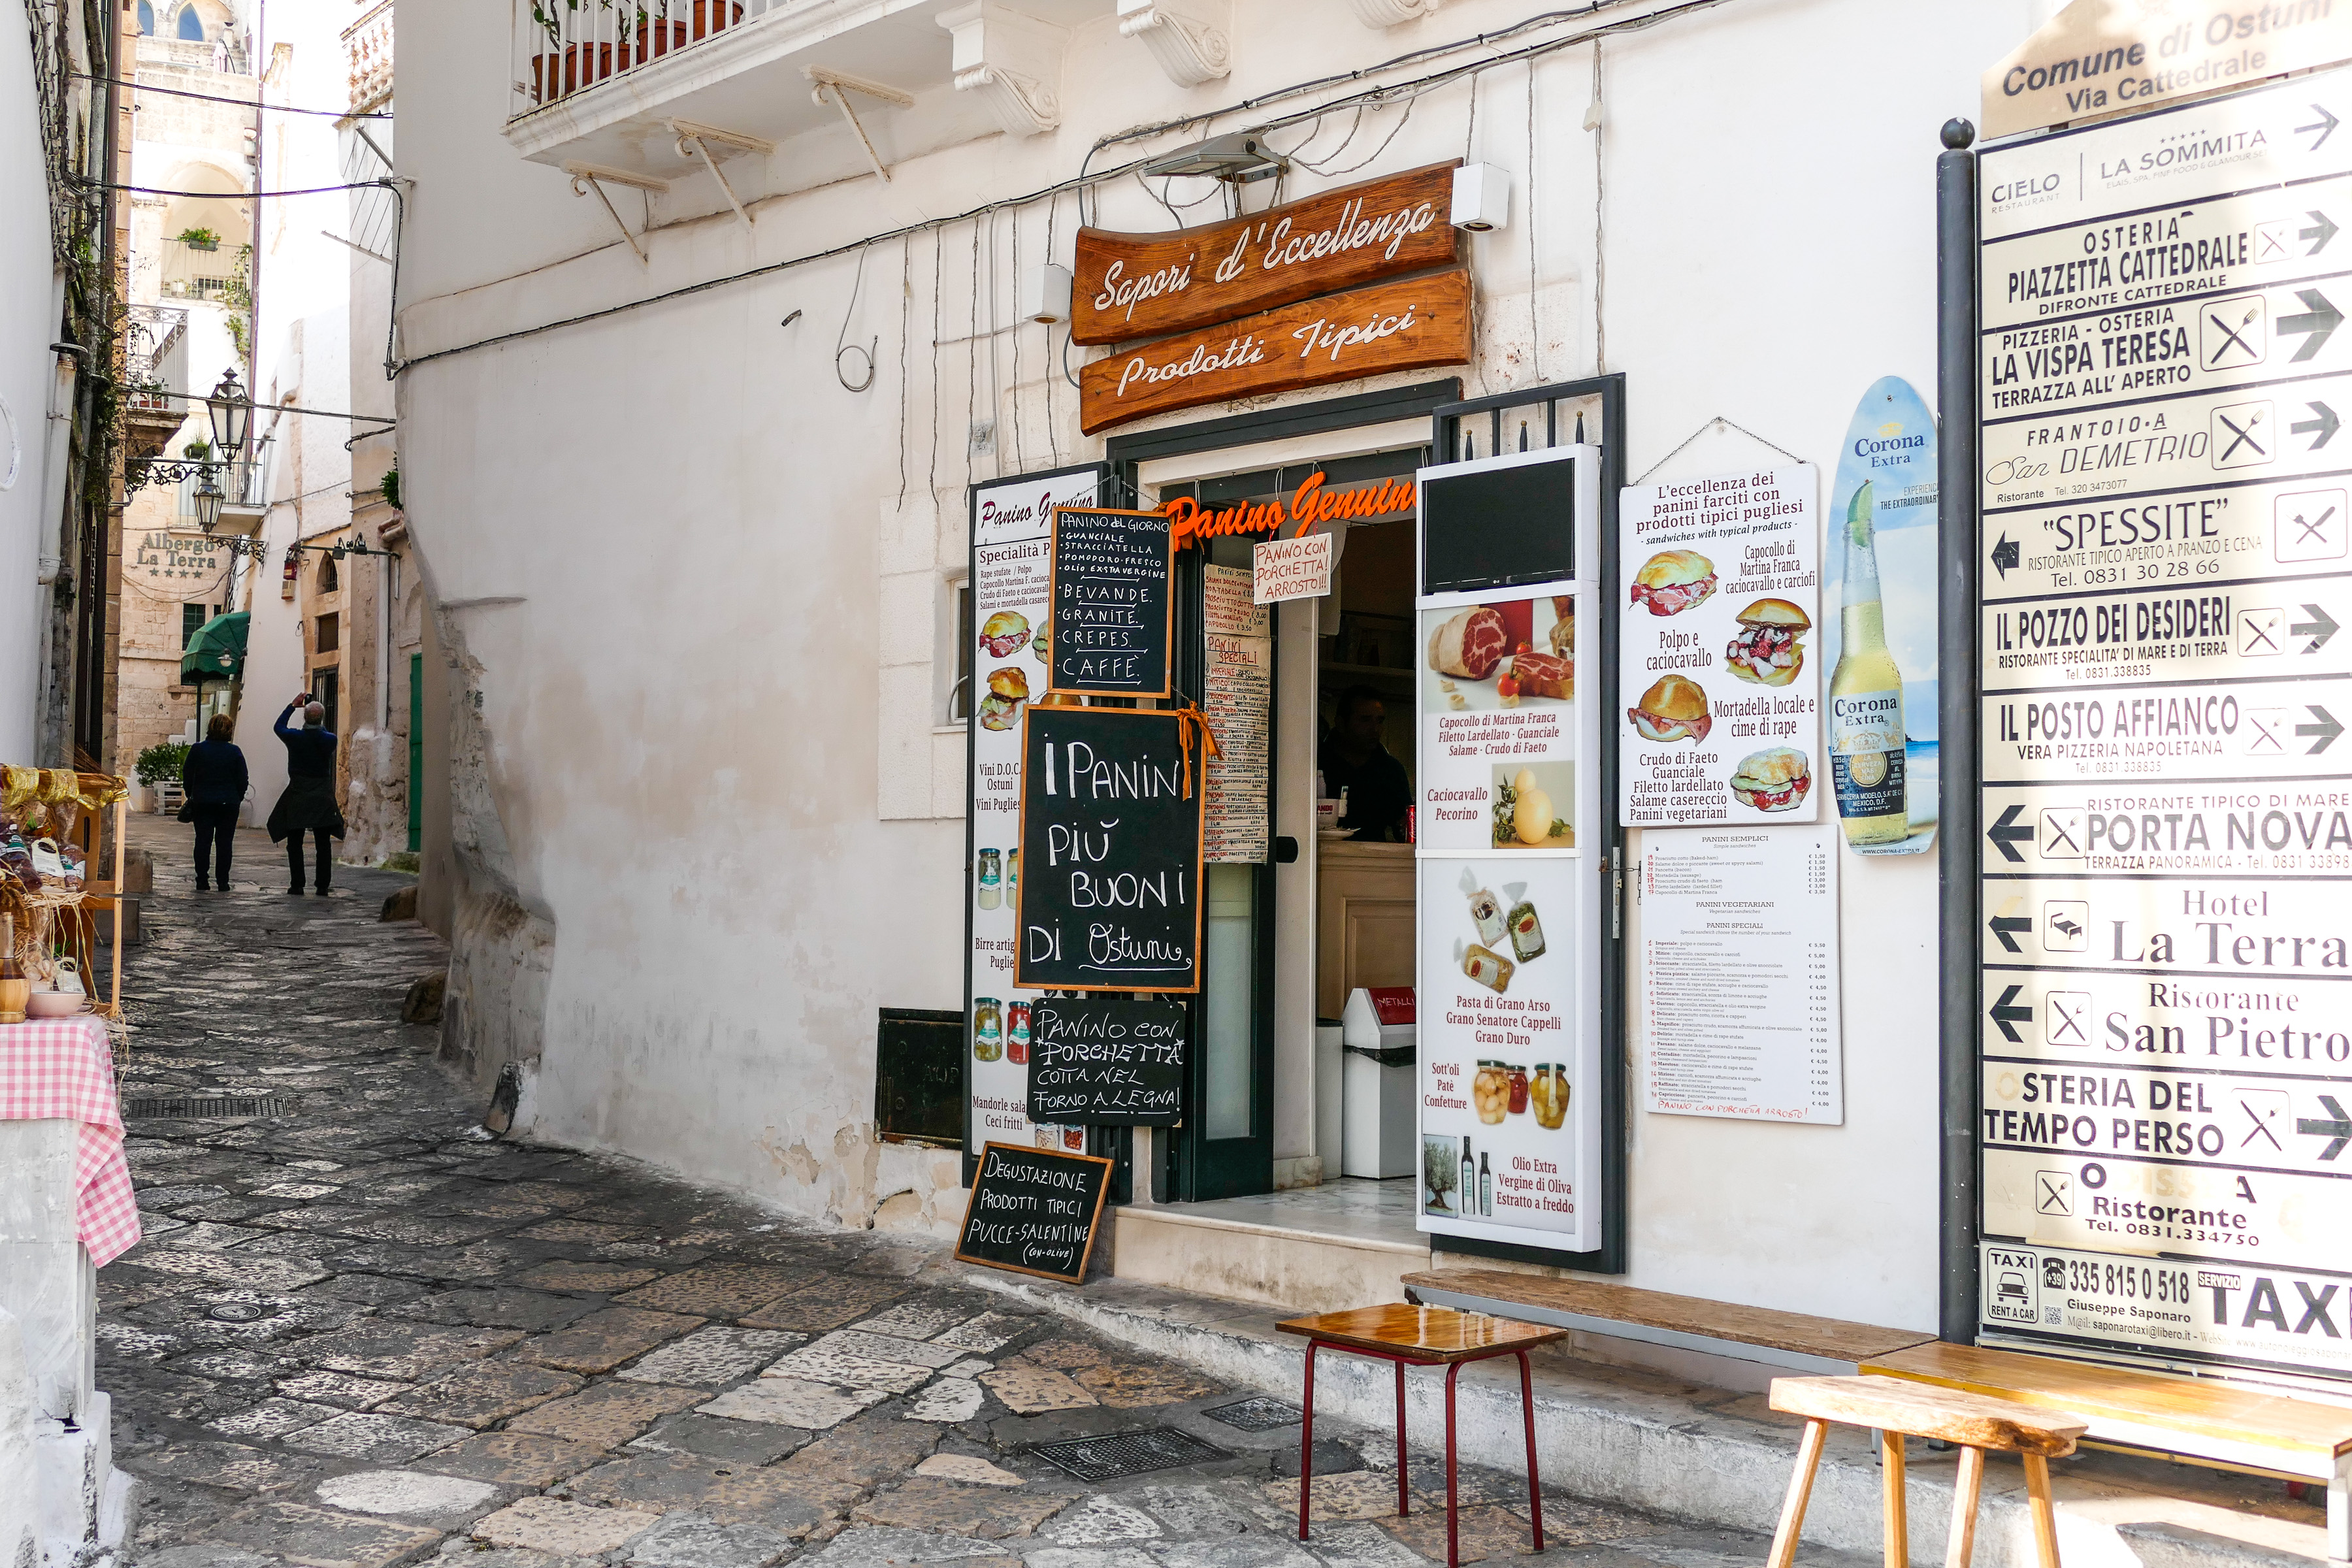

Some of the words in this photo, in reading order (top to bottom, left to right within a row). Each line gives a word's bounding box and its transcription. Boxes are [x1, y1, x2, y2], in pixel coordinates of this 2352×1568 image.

[2003, 41, 2146, 97] Comune
[2159, 20, 2191, 57] di
[2205, 0, 2331, 46] Ostuni
[2066, 88, 2108, 113] Via
[2117, 50, 2267, 101] Cattedrale
[2101, 159, 2131, 179] LA
[1991, 174, 2061, 203] CIELO
[1991, 193, 2061, 214] RESTAURANT
[2083, 218, 2180, 254] OSTERIA
[1094, 253, 1195, 323] Sapori
[1215, 197, 1437, 282] d'Eccellenza
[2008, 259, 2112, 304] PIAZZETTA
[2119, 231, 2247, 285] CATTEDRALE
[1117, 335, 1264, 397] Prodotti
[1292, 304, 1416, 360] Tipici
[1992, 353, 2018, 385] LA
[2026, 342, 2094, 379] VISPA
[2102, 326, 2191, 369] TERESA
[1855, 434, 1925, 457] Corona
[1986, 455, 2050, 485] San
[2060, 431, 2208, 474] DEMETRIO
[1871, 455, 1910, 468] Extra
[1658, 478, 1746, 500] L'eccellenza
[1750, 471, 1774, 489] dei
[1997, 489, 2044, 503] Ristorante
[2055, 486, 2068, 496] Tel.
[2071, 483, 2087, 494] 320
[2090, 480, 2127, 492] 3473077
[981, 501, 1032, 529] Panino
[1653, 497, 1699, 516] panini
[1703, 492, 1750, 510] farciti
[1754, 489, 1780, 503] con
[1166, 497, 1286, 552] Panino
[1636, 515, 1695, 534] prodotti
[1700, 508, 1740, 526] tipici
[1744, 500, 1803, 521] pugliesi
[142, 532, 215, 553] Albergo
[1646, 531, 1695, 545] sandwiches
[1698, 527, 1717, 539] with
[1720, 524, 1750, 539] typical
[1753, 520, 1792, 536] products
[137, 547, 158, 565] La
[167, 549, 216, 569] Terra
[980, 544, 1038, 565] Specialità
[1256, 542, 1301, 566] PANINO
[1305, 539, 1327, 555] CON
[981, 570, 992, 579] Rape
[994, 568, 1011, 576] stufate
[1256, 555, 1328, 587] PORCHETTA!
[2051, 572, 2077, 587] Tel.
[2084, 566, 2127, 585] 0831
[2137, 564, 2159, 581] 30
[2166, 561, 2189, 578] 28
[2197, 559, 2219, 575] 66
[1996, 613, 2012, 651] IL
[2019, 606, 2087, 649] POZZO
[2096, 604, 2128, 644] DEI
[2137, 596, 2230, 641] DESIDERI
[1646, 650, 1712, 671] caciocavallo
[1999, 652, 2058, 669] RISTORANTE
[2123, 647, 2134, 661] DI
[2138, 645, 2166, 660] MARE
[2170, 645, 2176, 657] E
[2178, 644, 2192, 657] DI
[2195, 642, 2228, 656] TERRA
[2066, 669, 2082, 680] Tel.
[2085, 664, 2151, 679] 0831.338835
[1835, 698, 1897, 717] Corona
[1846, 714, 1884, 727] Extra
[1439, 716, 1480, 729] Capocollo
[1482, 715, 1491, 727] di
[1494, 714, 1526, 726] Martina
[1527, 713, 1556, 724] Franca
[2017, 745, 2052, 760] VERA
[2057, 742, 2119, 759] PIZZERIA
[2125, 740, 2223, 757] NAPOLETANA
[1427, 787, 1488, 802] Caciocavallo
[1435, 808, 1478, 821] Pecorino
[1630, 808, 1663, 821] Panini
[1665, 808, 1727, 821] vegetariani
[2088, 813, 2211, 853] PORTA
[2228, 810, 2352, 851] NOVA
[1071, 864, 1184, 908] BUONI
[2182, 890, 2268, 917] Hotel
[1028, 919, 1062, 964] DI
[2109, 920, 2175, 963] La
[2195, 922, 2349, 969] Terra
[1037, 1010, 1126, 1040] PANINO
[1446, 1013, 1474, 1026] Grano
[1477, 1015, 1518, 1027] Senatore
[1521, 1015, 1561, 1030] Cappelli
[2106, 1011, 2186, 1054] San
[2205, 1016, 2350, 1062] Pietro
[1039, 1043, 1183, 1066] PORCHETTA
[1037, 1069, 1089, 1085] COTTA
[1095, 1070, 1144, 1085] NEL
[1432, 1062, 1460, 1077] Sott'oli
[1437, 1079, 1454, 1092] Patè
[972, 1095, 1008, 1113] Mandorle
[1034, 1091, 1087, 1110] FORNO
[1094, 1094, 1107, 1105] A
[1424, 1094, 1467, 1109] Confetture
[1658, 1100, 1691, 1110] PANINO
[1718, 1105, 1760, 1115] PORCHETTA
[986, 1115, 1001, 1128] Ceci
[1003, 1117, 1022, 1130] fritti
[1984, 1108, 2097, 1147] TEMPO
[2112, 1119, 2224, 1156] PERSO
[985, 1152, 1086, 1193] DEGUSTAZIONE
[981, 1189, 1037, 1211] PRODOTTI
[1047, 1199, 1081, 1218] TIPICI
[2092, 1196, 2247, 1229] Ristorante
[2085, 1219, 2119, 1233] Tel.
[2126, 1222, 2259, 1247] 0831.334750
[1991, 1253, 2034, 1269] TAXI
[2070, 1261, 2099, 1292] 335
[2105, 1264, 2136, 1297] 815
[2142, 1267, 2151, 1299] 0
[2158, 1270, 2189, 1304] 518
[2198, 1271, 2241, 1291] SERVIZIO
[2067, 1298, 2125, 1316] Giuseppe
[2129, 1307, 2191, 1324] Saponaro
[2093, 1321, 2191, 1341] saponarotaxi@libero.it
